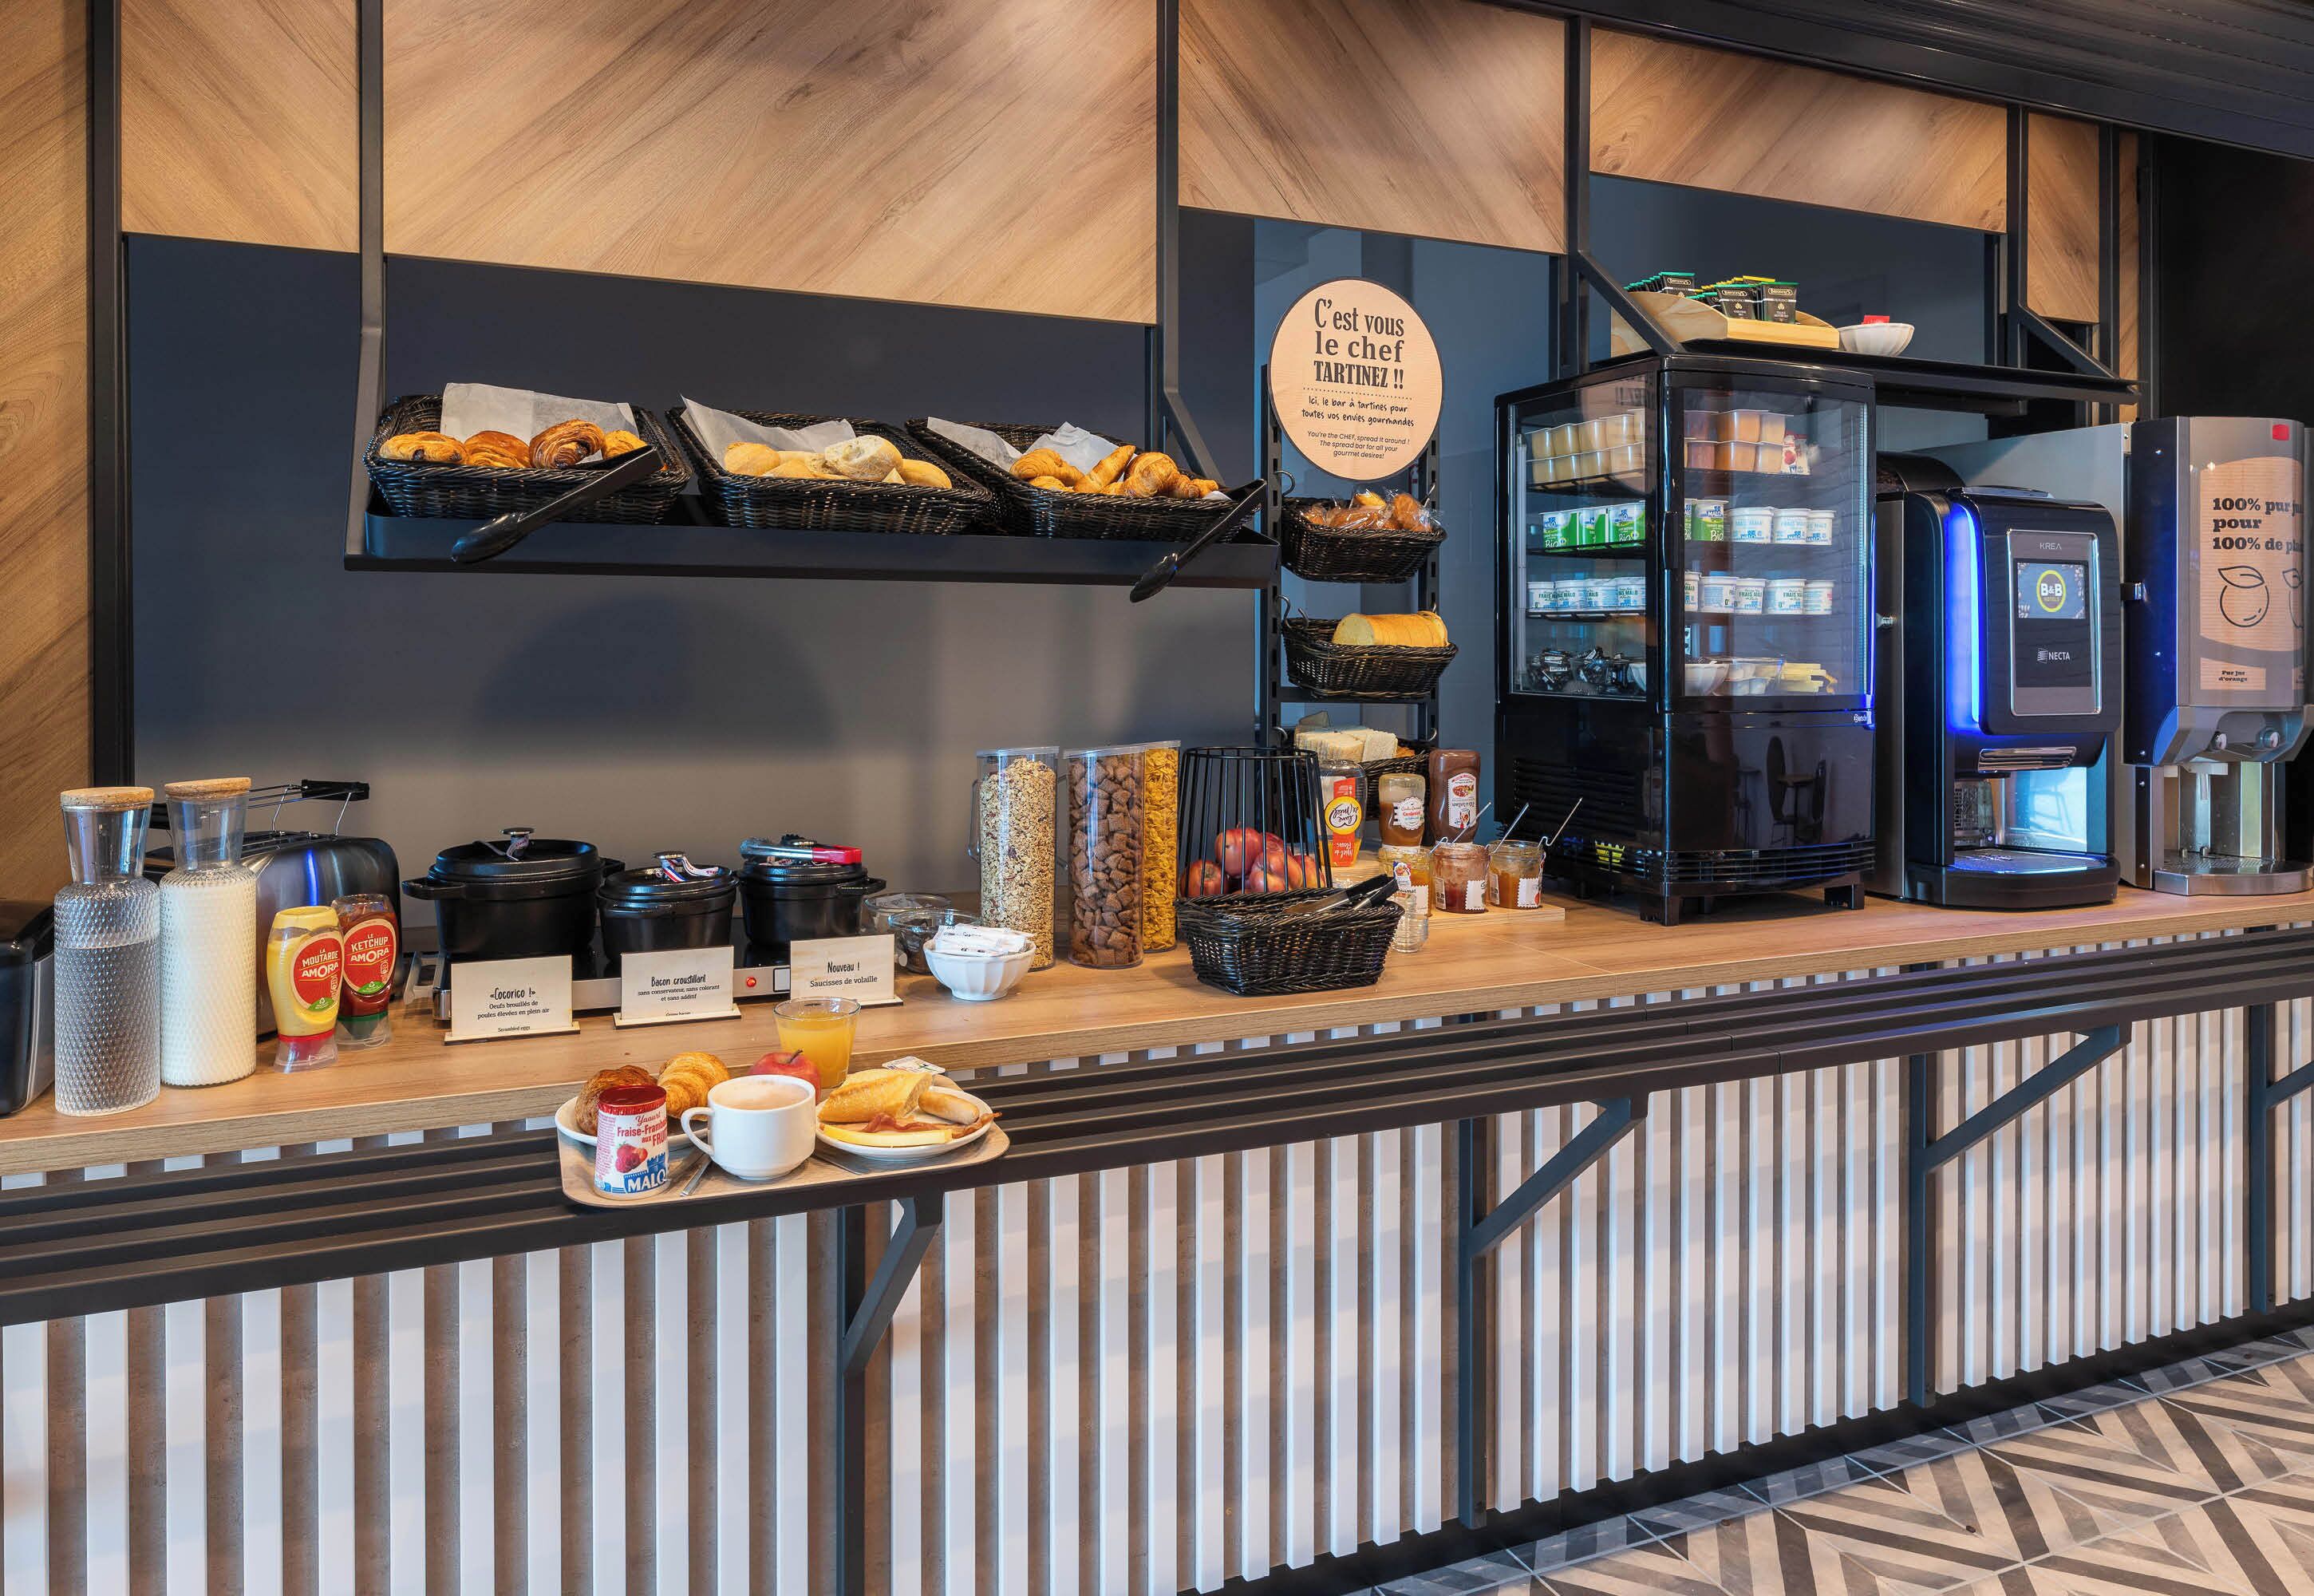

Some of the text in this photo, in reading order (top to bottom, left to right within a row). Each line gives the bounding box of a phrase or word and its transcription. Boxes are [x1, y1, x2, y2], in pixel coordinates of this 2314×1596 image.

[1315, 298, 1404, 337] C'est vous
[1315, 330, 1404, 362] le chef
[1313, 361, 1404, 389] TARTINEZ !!
[1322, 397, 1329, 406] le
[1332, 398, 1346, 407] bar
[1349, 397, 1355, 407] à
[1357, 400, 1387, 411] tartines
[1390, 405, 1408, 414] pour
[1301, 409, 1325, 419] toutes
[1343, 413, 1365, 423] envies
[1368, 417, 1414, 427] gourmandes
[2213, 498, 2261, 511] 100%
[2265, 501, 2290, 515] pur
[2213, 519, 2262, 532] pour
[2213, 537, 2261, 550] 100%
[2265, 538, 2283, 551] de
[2040, 583, 2063, 596] B&B
[2048, 652, 2071, 661] NECTA
[351, 936, 389, 952] KETCHUP
[302, 950, 338, 967] MOUTARDE
[350, 947, 389, 962] AMORA
[302, 962, 339, 978] AMORA
[827, 961, 860, 974] Nouveau !
[651, 974, 706, 987] Bacon croustillant
[810, 979, 843, 988] Saucisses
[628, 1168, 666, 1193] MALO
